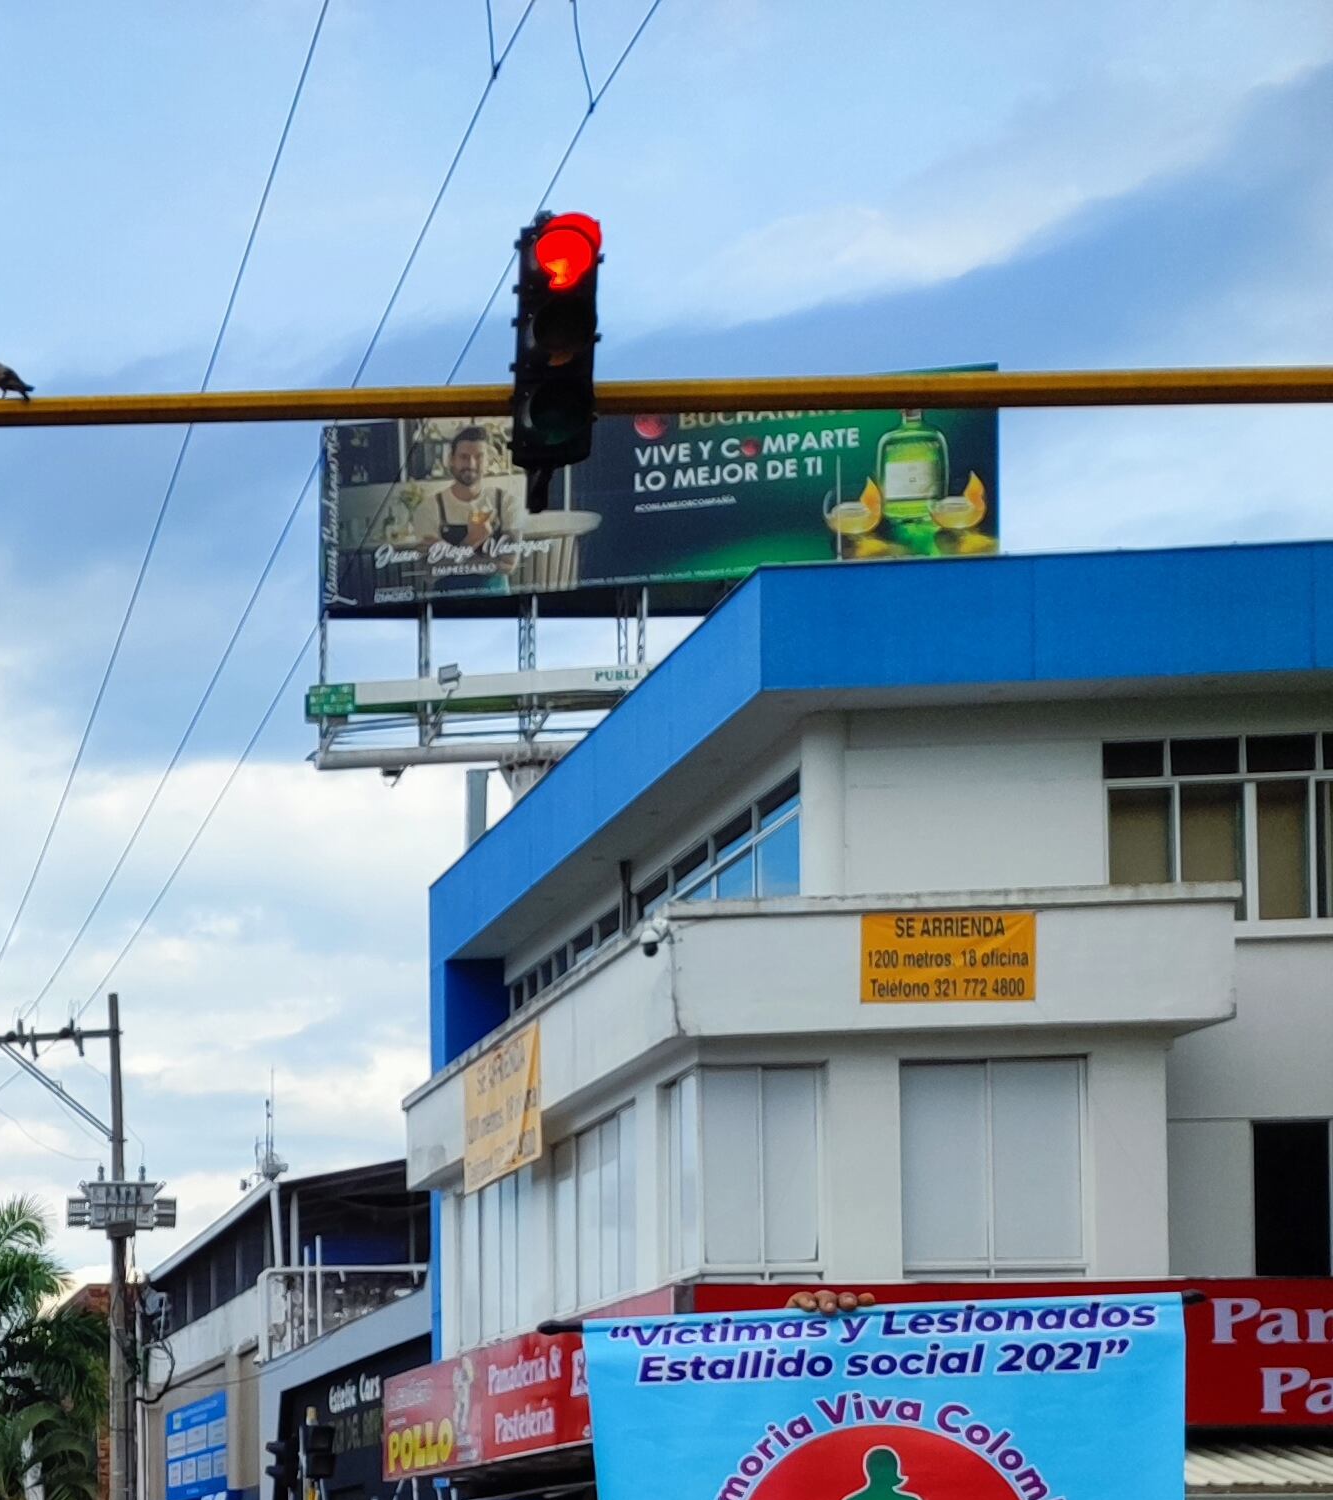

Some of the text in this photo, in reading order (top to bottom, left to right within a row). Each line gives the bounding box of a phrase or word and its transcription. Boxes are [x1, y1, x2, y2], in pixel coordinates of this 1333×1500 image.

[635, 443, 690, 466] VIVE
[699, 440, 712, 460] Y
[635, 457, 822, 493] LO MEJOR DE TI
[375, 545, 421, 569] Juan
[432, 563, 496, 575] EMPRESARIO
[895, 917, 1005, 937] SE ARRIENDA
[869, 950, 898, 968] 1200
[961, 950, 977, 966] 18
[982, 950, 1029, 967] oficina
[871, 978, 1025, 997] Teléfono 321 772 4800
[839, 1319, 867, 1344] y
[881, 1301, 1157, 1336] Lesionados
[639, 1348, 832, 1383] Estallido
[847, 1344, 984, 1377] social
[359, 1373, 380, 1402] Cars
[817, 1393, 922, 1424] Viva
[388, 1418, 453, 1473] POLLO
